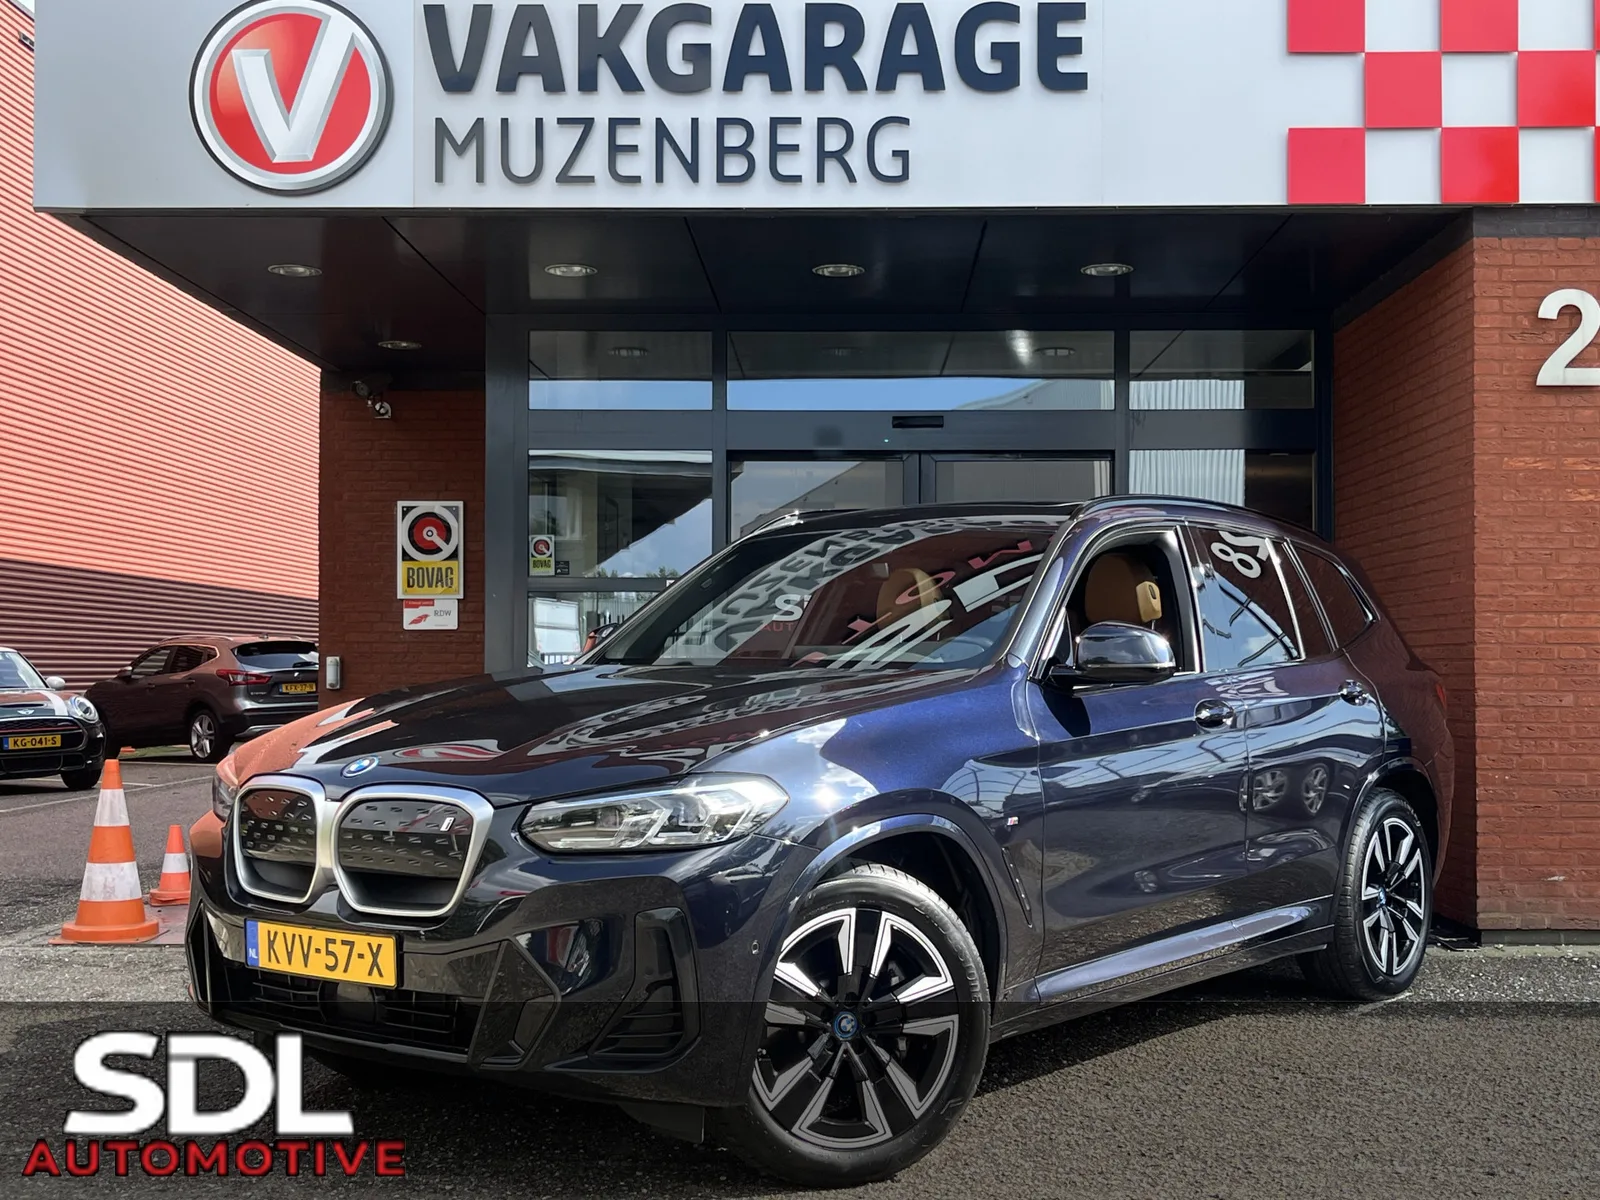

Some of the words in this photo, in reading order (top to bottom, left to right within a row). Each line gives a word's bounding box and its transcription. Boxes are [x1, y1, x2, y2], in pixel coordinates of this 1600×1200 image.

[423, 1, 1088, 93] VAKGARAGE
[434, 116, 910, 184] MUZENBERG
[1536, 288, 1600, 386] 2
[406, 566, 454, 589] BOVAG
[433, 609, 452, 617] RDW
[13, 737, 57, 748] KG-041-S
[248, 947, 258, 959] NL
[266, 929, 384, 978] KVV-57-X
